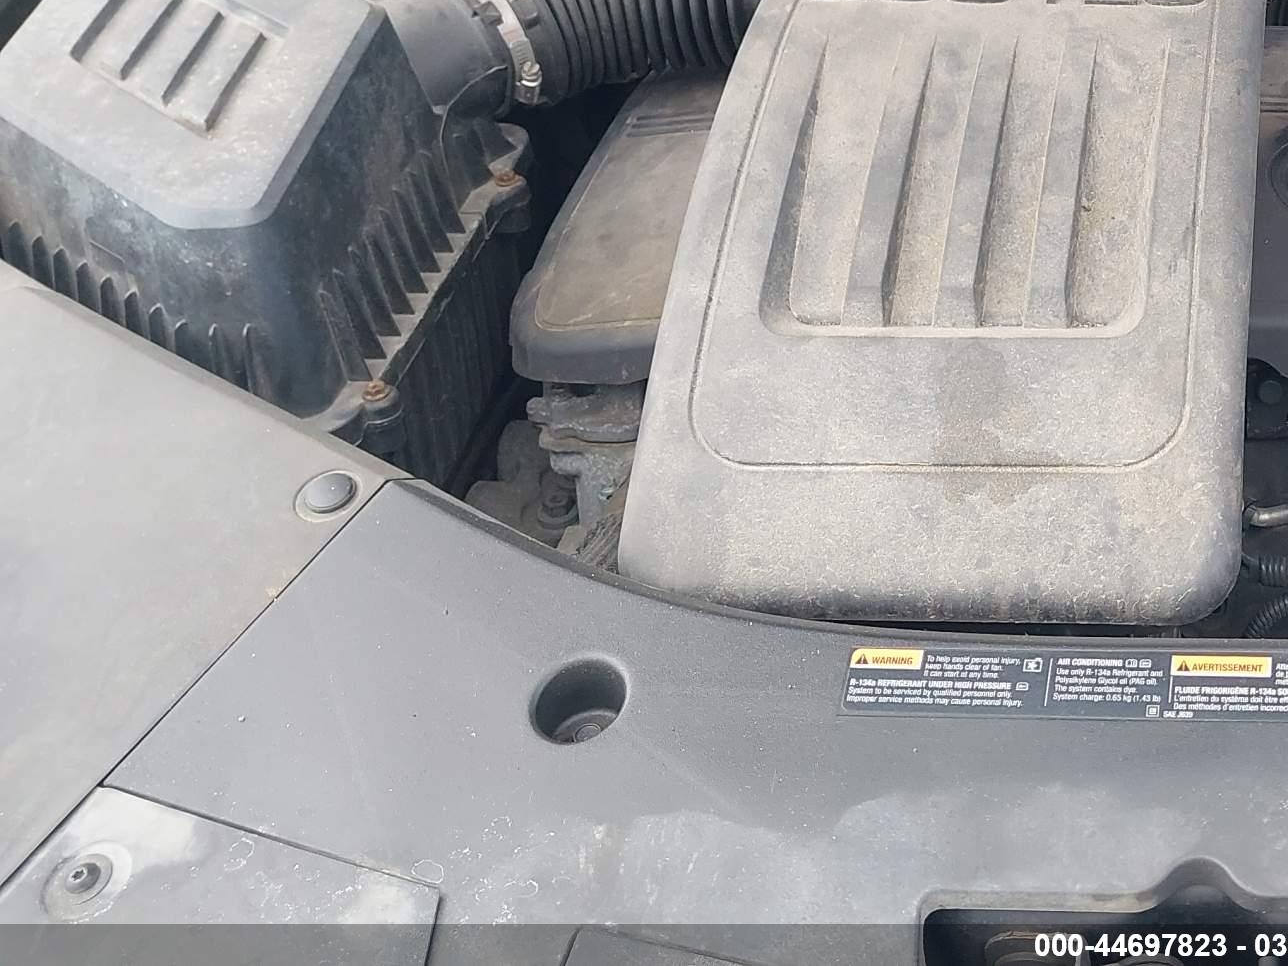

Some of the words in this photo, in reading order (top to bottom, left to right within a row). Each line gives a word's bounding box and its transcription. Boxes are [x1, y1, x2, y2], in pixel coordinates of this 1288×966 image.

[872, 656, 913, 665] WARNING
[936, 655, 951, 663] help
[971, 657, 1000, 665] personal
[1072, 658, 1123, 667] CONDITIONING
[1191, 663, 1263, 672] AVERTISSEMENT
[1070, 668, 1084, 676] only
[1086, 668, 1111, 676] R-134a
[1111, 669, 1149, 677] Refrigerant
[850, 678, 876, 686] R-134a
[877, 679, 928, 688] REFRIGERANT
[928, 680, 953, 688] UNDER
[973, 682, 1012, 690] PRESSURE
[1097, 677, 1118, 685] Glycol
[1119, 677, 1127, 685] oil
[848, 687, 874, 695] System
[874, 687, 882, 695] to
[883, 688, 892, 696] be
[893, 688, 921, 696] serviced
[922, 689, 932, 697] by
[933, 689, 962, 698] qualified
[963, 691, 996, 699] personnel
[1069, 685, 1093, 693] system
[1174, 686, 1200, 694] FLUIDE
[1250, 687, 1276, 695] R-134a
[846, 695, 877, 704] Improper
[878, 696, 903, 704] service
[904, 696, 934, 704] methods
[935, 698, 950, 706] may
[972, 698, 1001, 707] personal
[1052, 693, 1078, 701] System
[1079, 693, 1104, 702] charge:
[1123, 694, 1132, 702] kg
[1132, 694, 1151, 702] (1.43
[1221, 695, 1249, 703] système
[1250, 695, 1263, 703] doit
[1264, 695, 1278, 703] être
